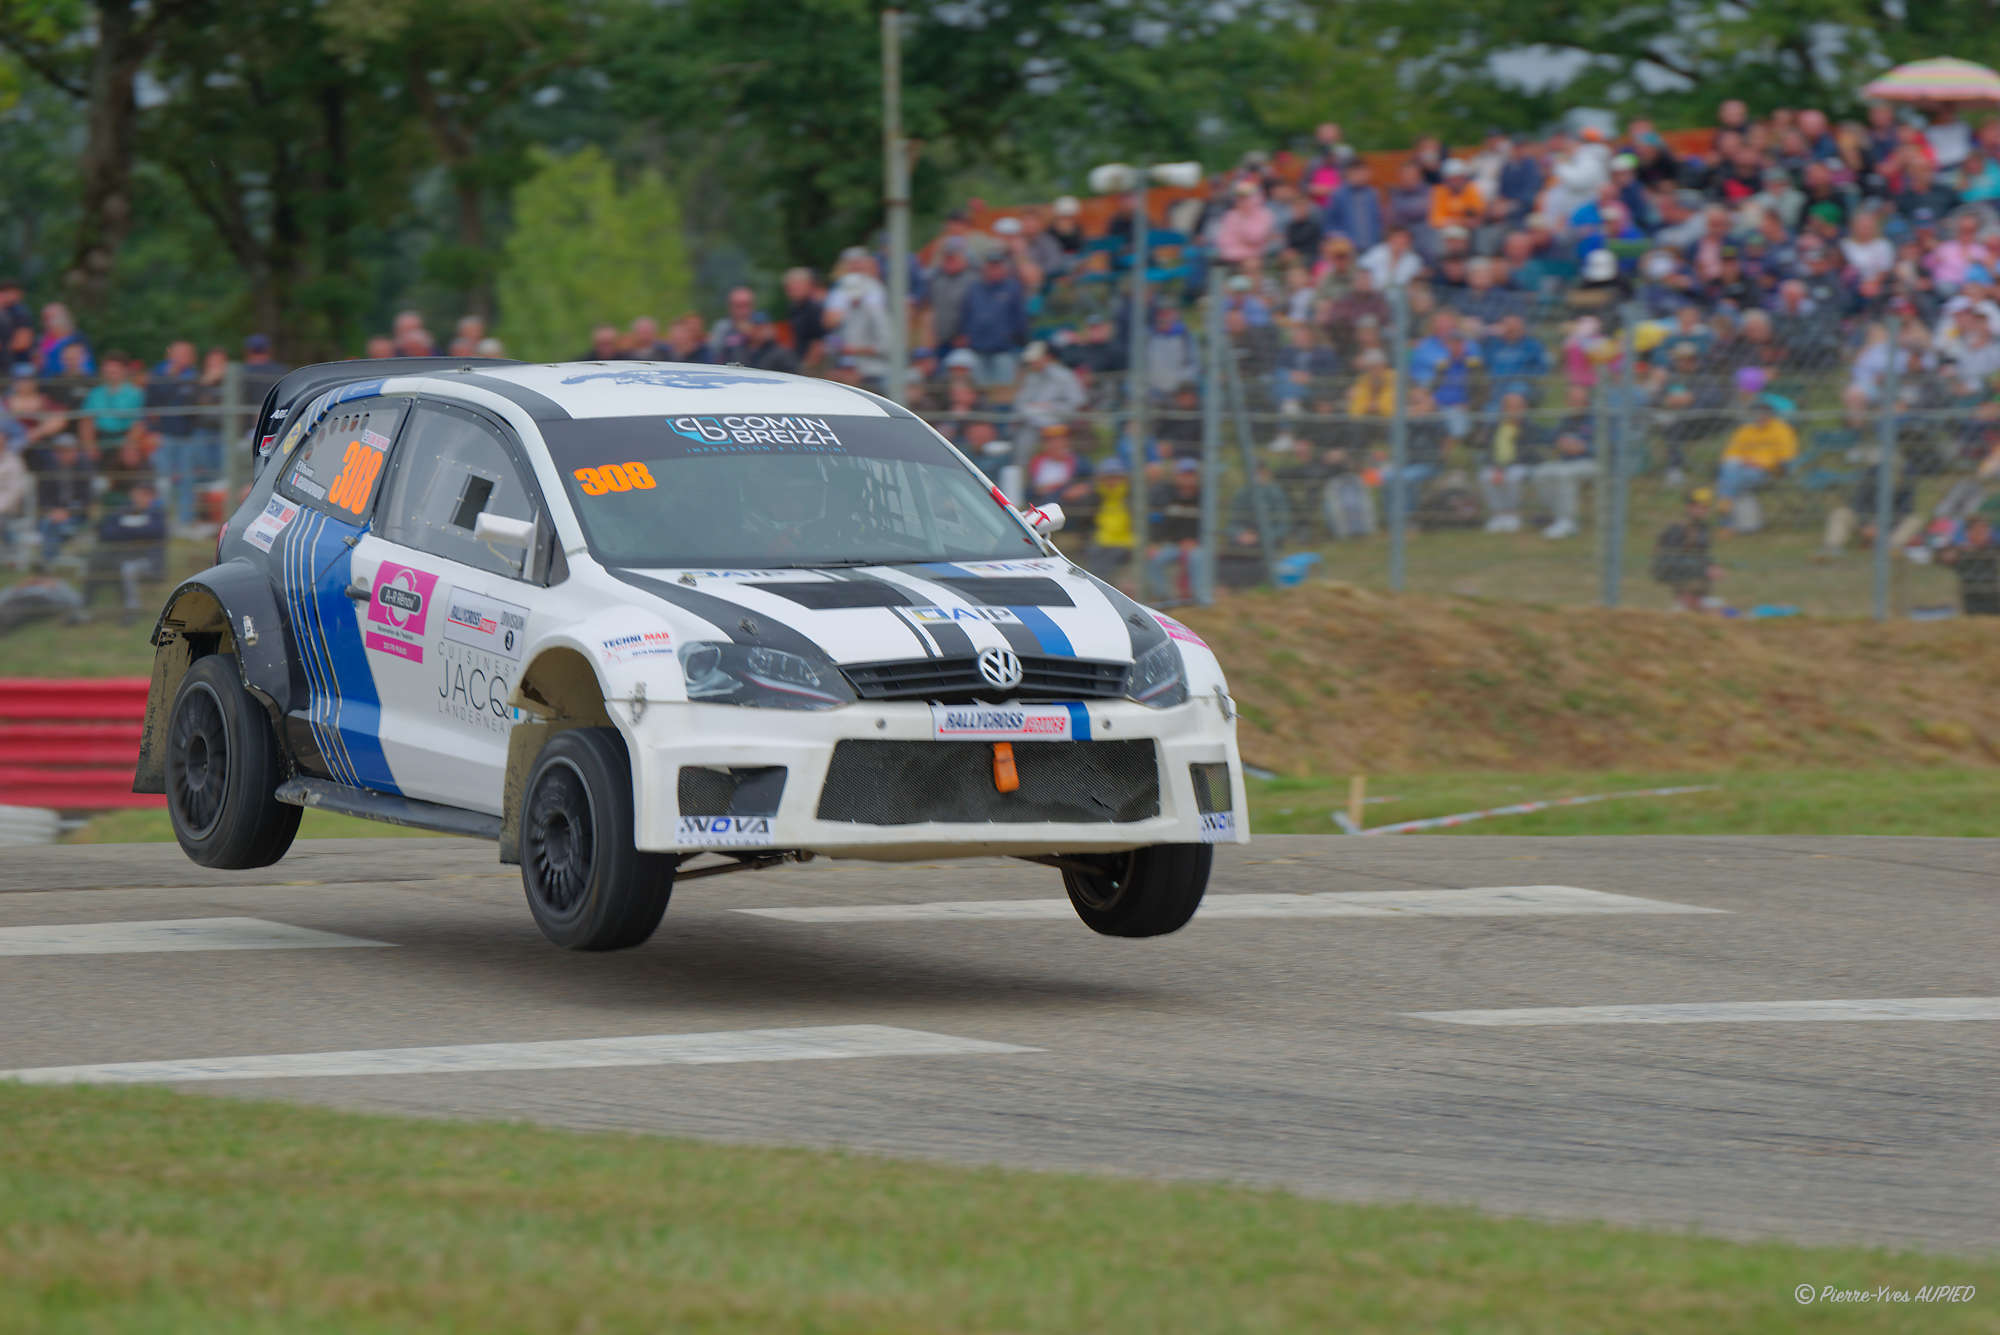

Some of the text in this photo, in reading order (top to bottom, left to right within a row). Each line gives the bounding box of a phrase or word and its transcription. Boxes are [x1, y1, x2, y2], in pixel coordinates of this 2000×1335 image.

[729, 429, 842, 446] BREIZH
[328, 440, 384, 515] 308
[573, 461, 656, 496] 308
[438, 641, 510, 677] CUISINES
[946, 711, 1024, 729] RALLYCROSS
